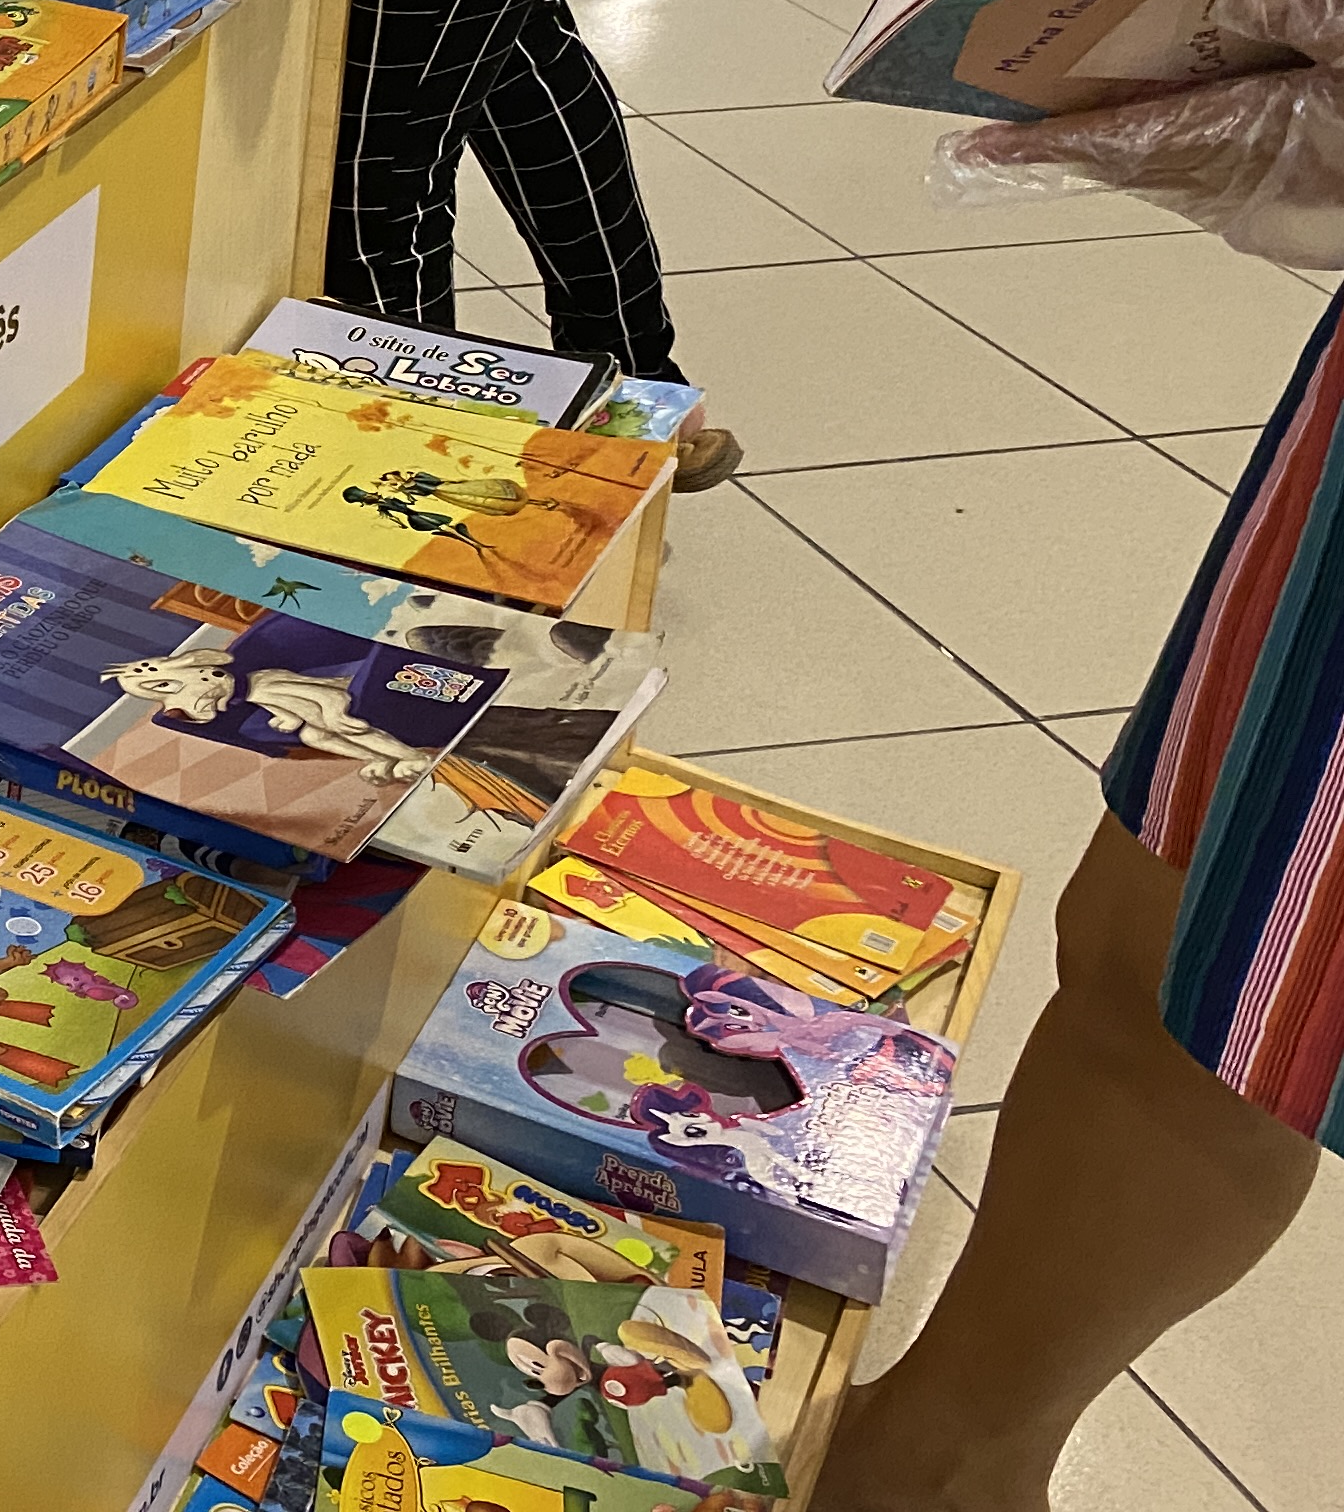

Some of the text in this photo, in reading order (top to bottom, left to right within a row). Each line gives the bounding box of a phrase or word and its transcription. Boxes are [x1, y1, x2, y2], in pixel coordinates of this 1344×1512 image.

[995, 23, 1065, 74] Mirna
[346, 326, 536, 388] O sítio de Seu
[384, 357, 524, 407] Lobato
[144, 453, 220, 502] Muito
[230, 401, 299, 465] barulho
[237, 479, 275, 510] por
[274, 439, 324, 480] nada
[598, 819, 647, 858] Eternos
[20, 863, 57, 887] 25
[67, 882, 105, 905] 16
[490, 978, 554, 1040] MOVIE
[596, 1168, 682, 1214] Aprenda
[603, 1153, 677, 1197] Prenda
[13, 1248, 33, 1271] da
[416, 1303, 462, 1388] Brilhantes
[230, 1438, 270, 1478] Coleção
